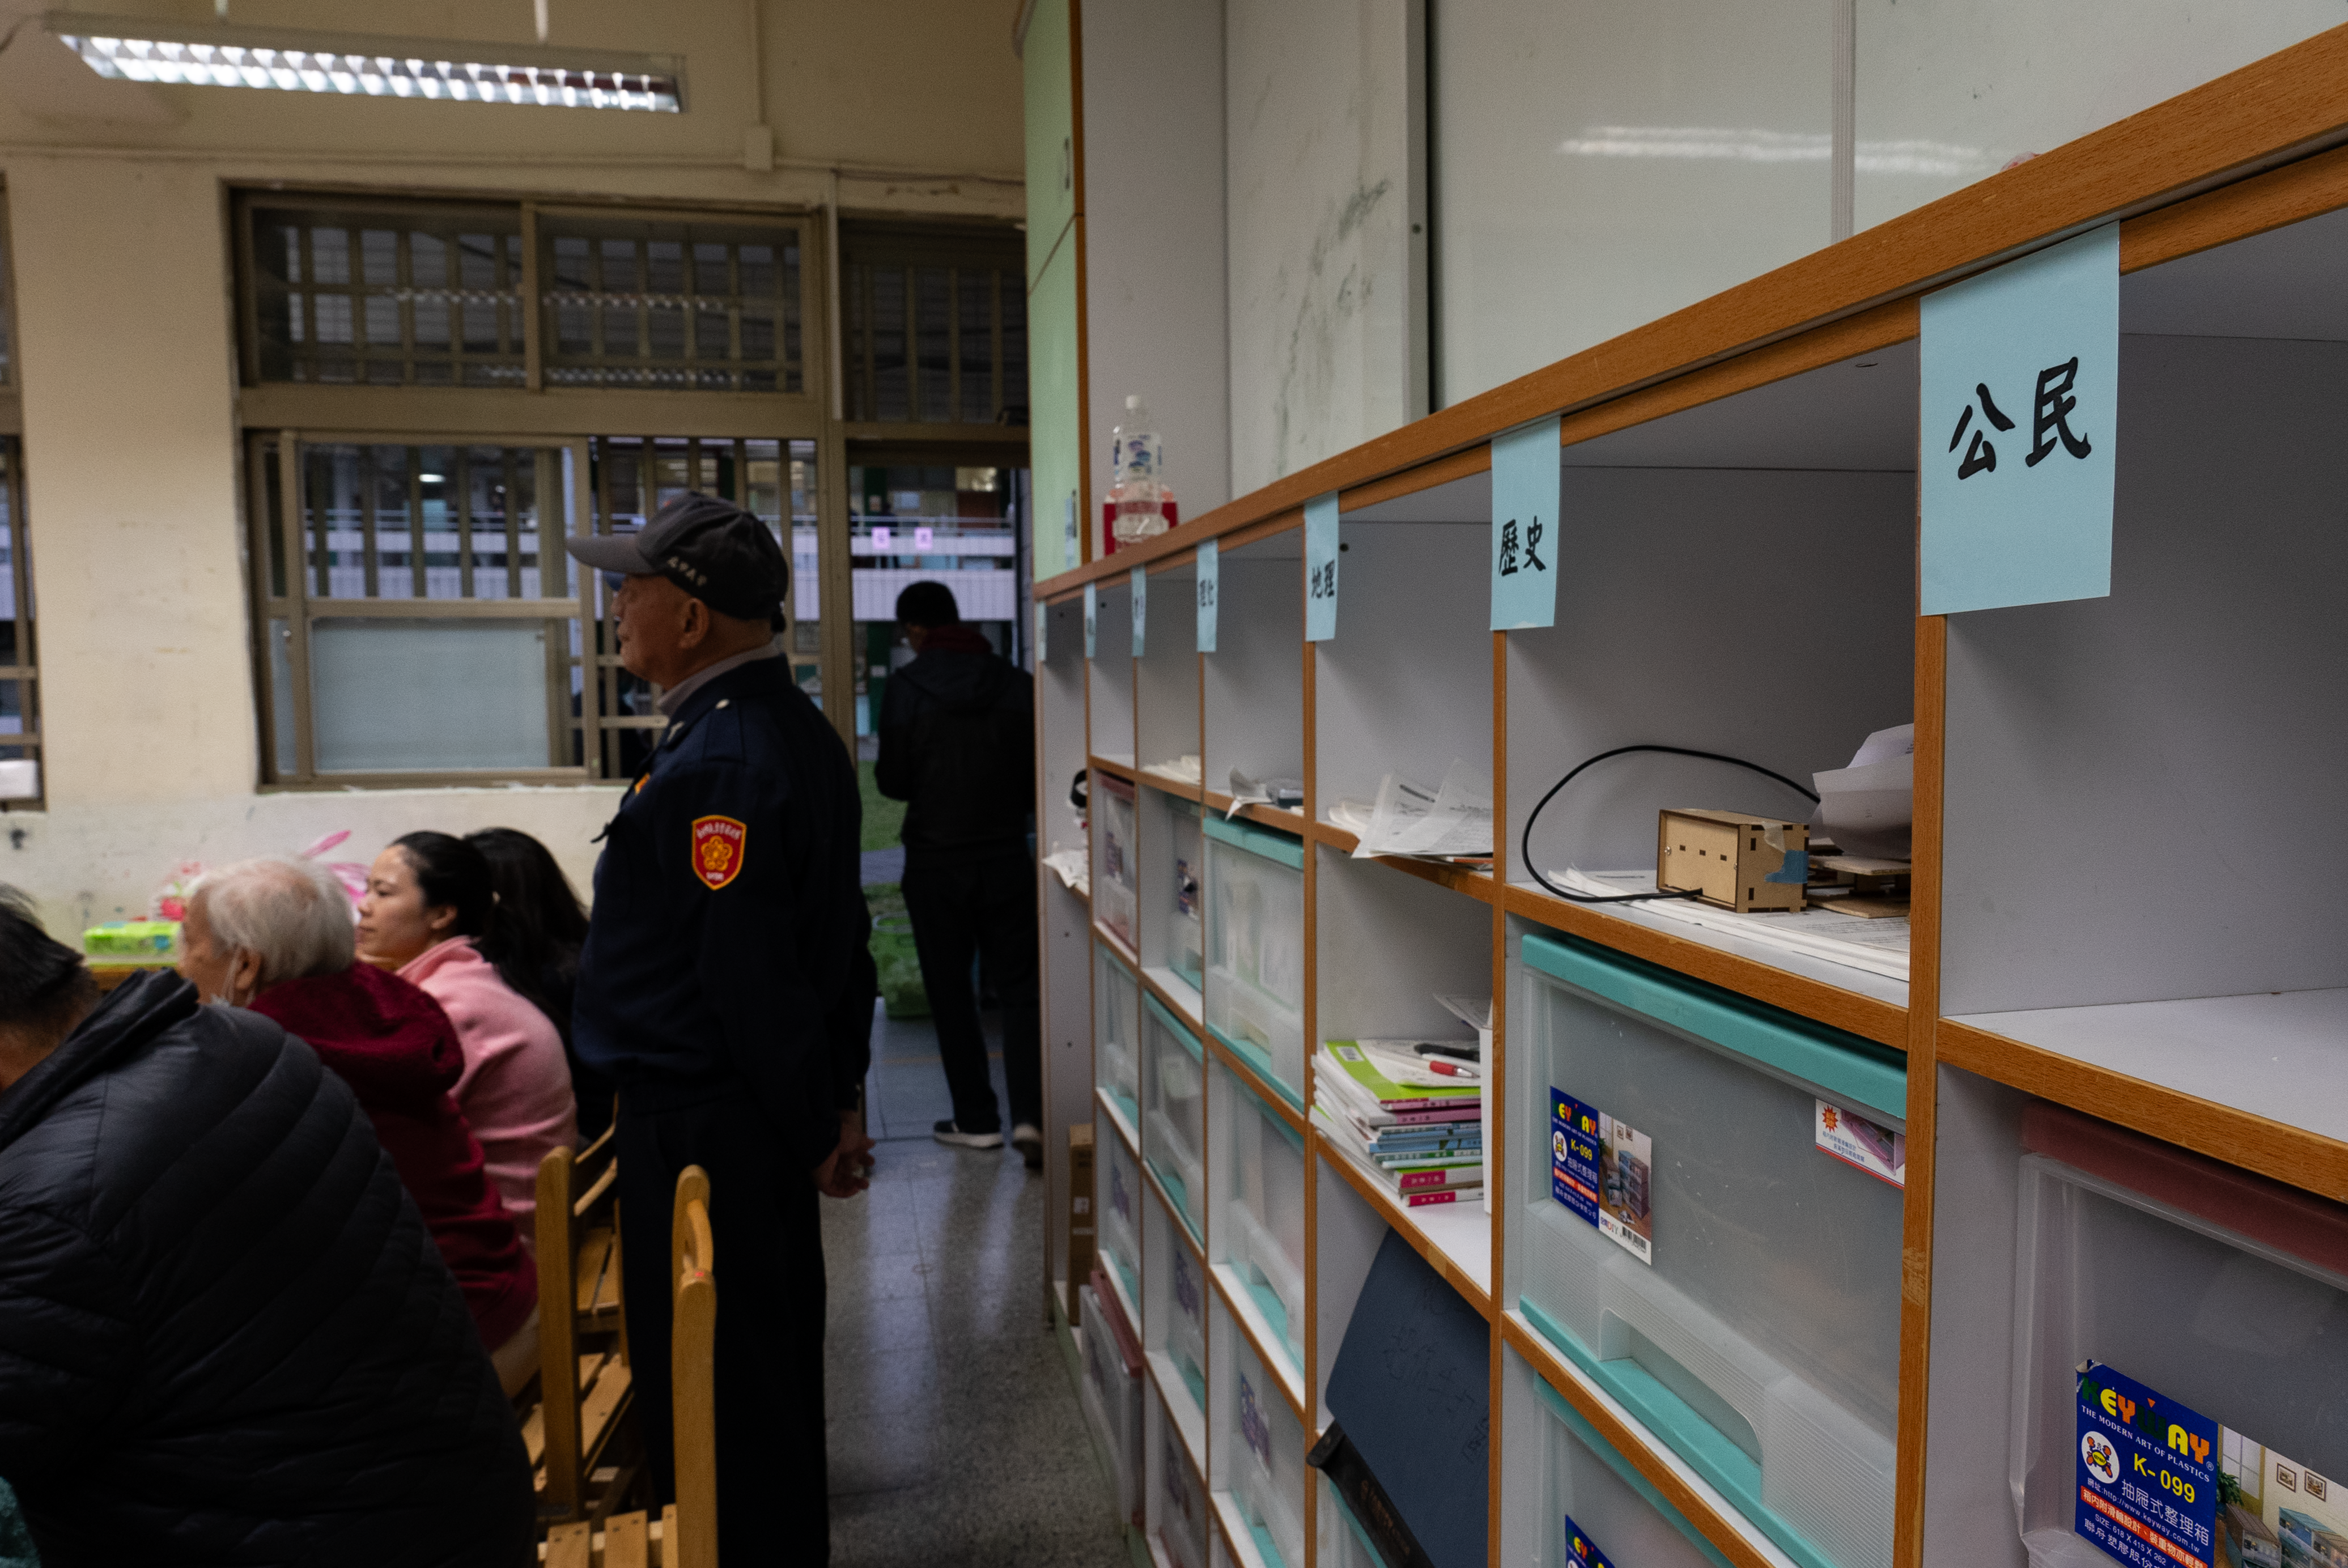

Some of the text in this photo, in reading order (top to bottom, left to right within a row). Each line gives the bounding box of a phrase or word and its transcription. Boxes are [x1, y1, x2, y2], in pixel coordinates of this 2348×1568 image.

[1948, 356, 2092, 481] 公民
[1311, 559, 1335, 598] 地理
[1499, 515, 1547, 577] 歷史
[2082, 1375, 2210, 1464] KEYWAY
[2082, 1405, 2210, 1482] THE MODERN ART OF PLASTICS
[2084, 1518, 2160, 1568] 聯府塑膠股份
[2095, 1514, 2166, 1566] SIZE: 618 X 415 X 262
[2121, 1478, 2210, 1546] 抽屜式整理箱
